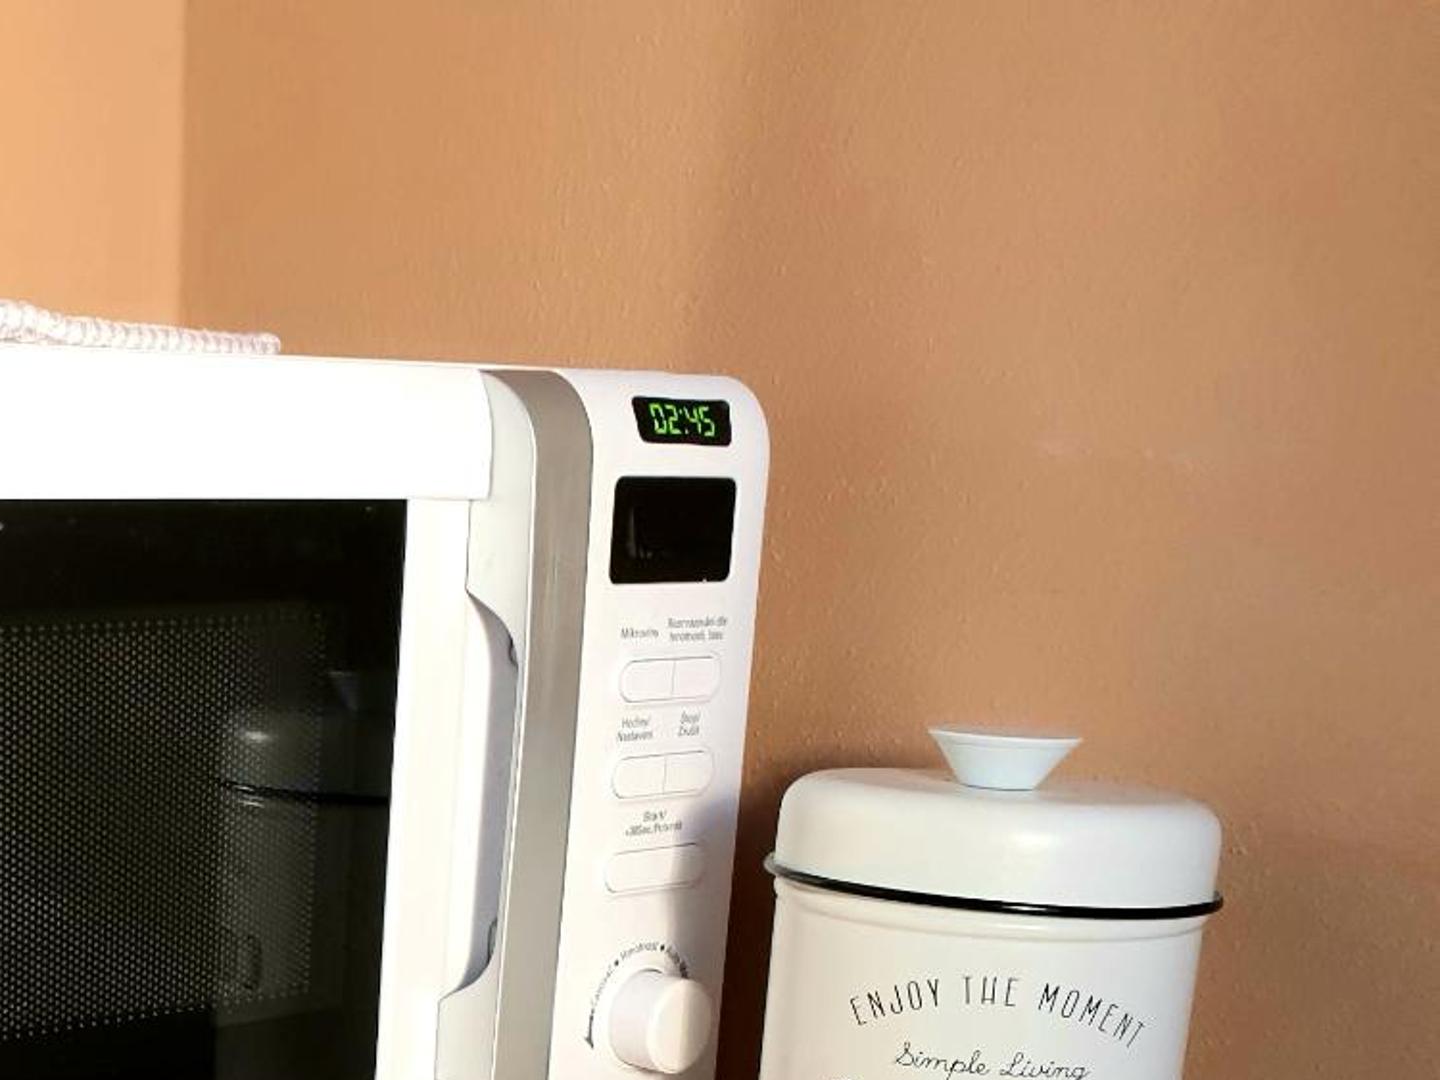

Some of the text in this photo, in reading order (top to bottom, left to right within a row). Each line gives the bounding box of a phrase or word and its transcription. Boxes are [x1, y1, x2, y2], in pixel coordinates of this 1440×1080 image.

[648, 403, 715, 437] 02:45
[849, 975, 1147, 1049] ENJOY THE MOMENT
